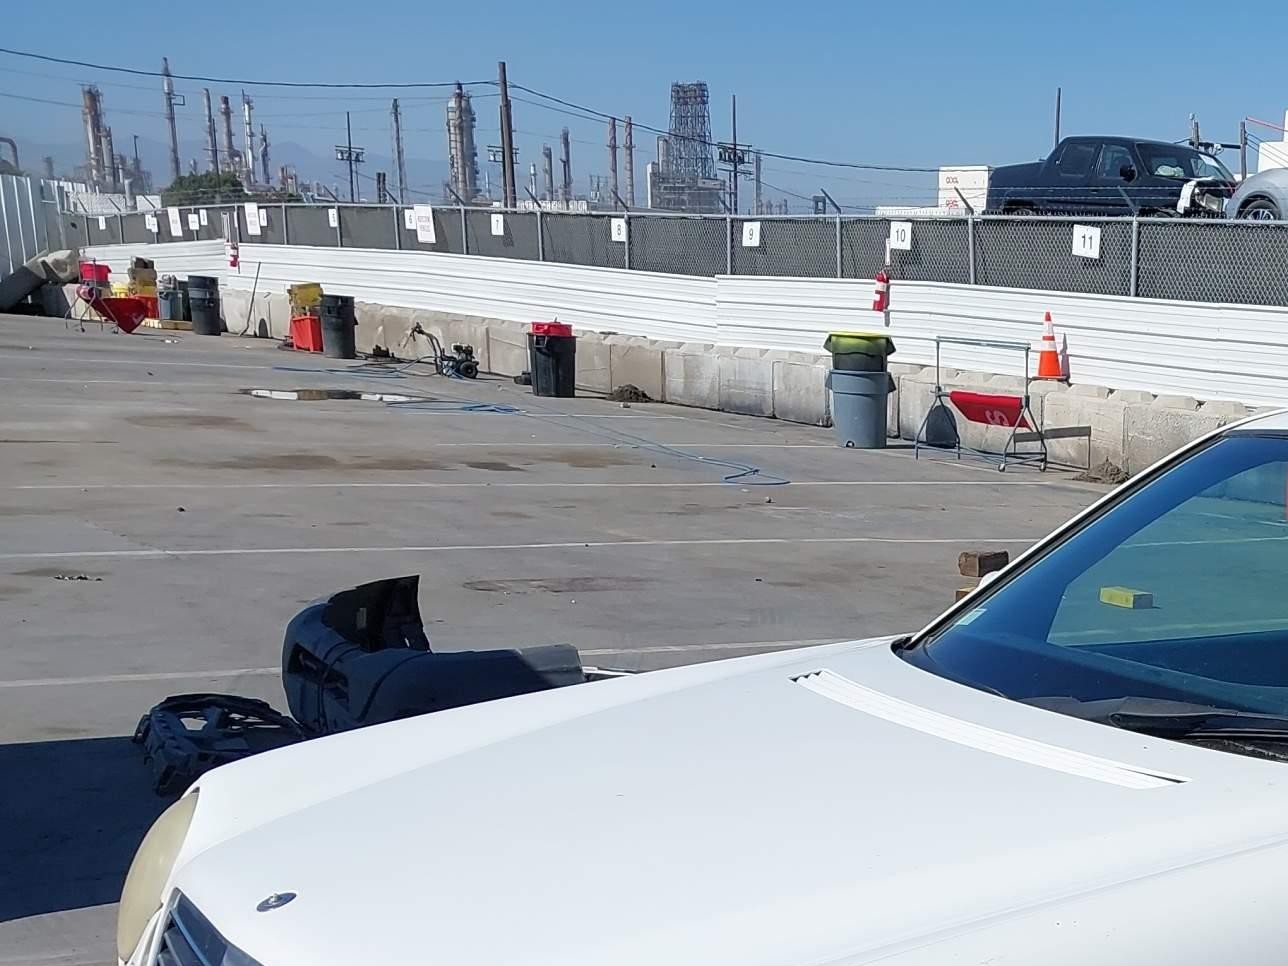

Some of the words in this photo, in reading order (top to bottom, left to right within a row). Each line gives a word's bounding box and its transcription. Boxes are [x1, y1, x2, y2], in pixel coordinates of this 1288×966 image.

[748, 227, 754, 241] 9
[895, 228, 906, 243] 10
[1081, 233, 1093, 250] 11
